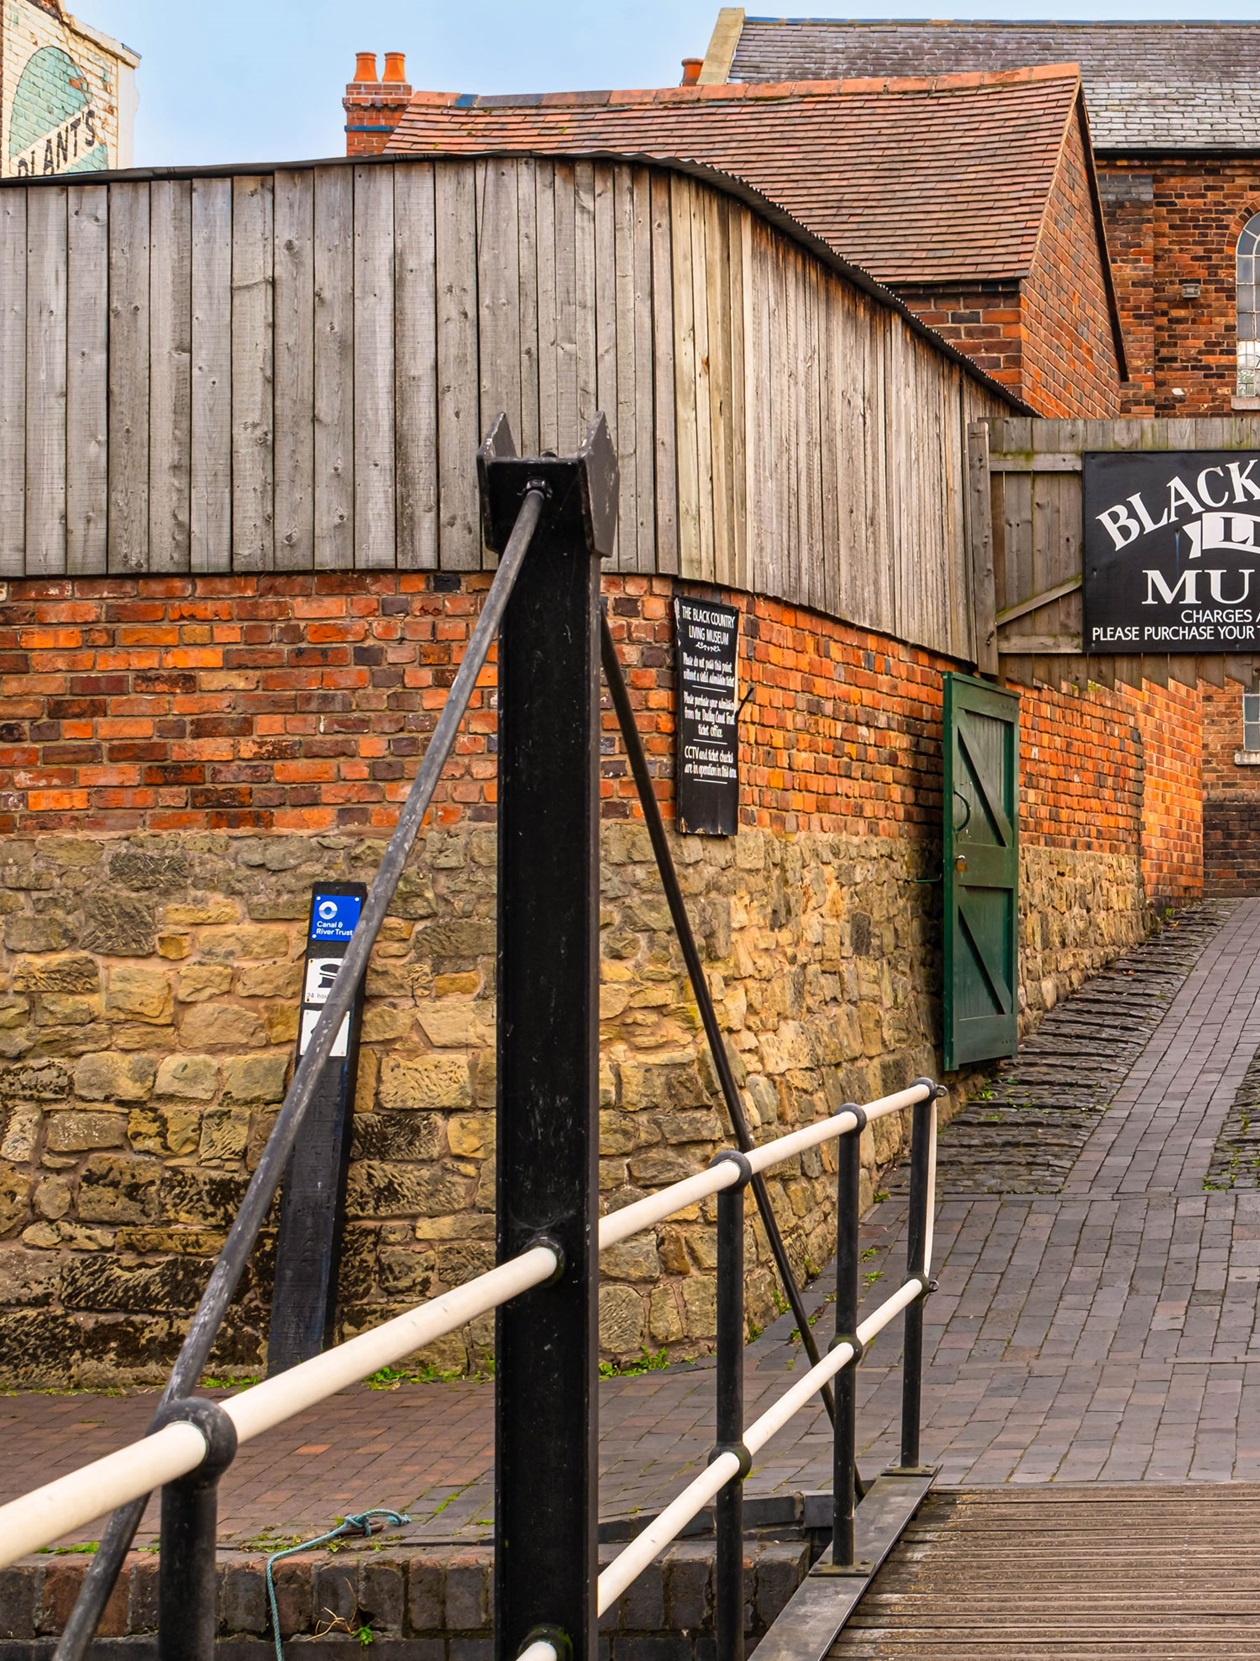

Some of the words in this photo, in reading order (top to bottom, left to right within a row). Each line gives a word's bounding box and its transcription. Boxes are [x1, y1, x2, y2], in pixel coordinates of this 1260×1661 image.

[682, 605, 692, 620] THE
[692, 608, 710, 624] BLACK
[711, 612, 736, 629] COUNTRY
[1181, 609, 1253, 623] CHARGES
[688, 625, 705, 640] LIVING
[706, 629, 729, 645] MUSEUM
[1092, 627, 1140, 641] PLEASE
[1144, 626, 1215, 640] PURCHASE
[1219, 626, 1255, 639] YOUR
[684, 745, 699, 759] CCTV
